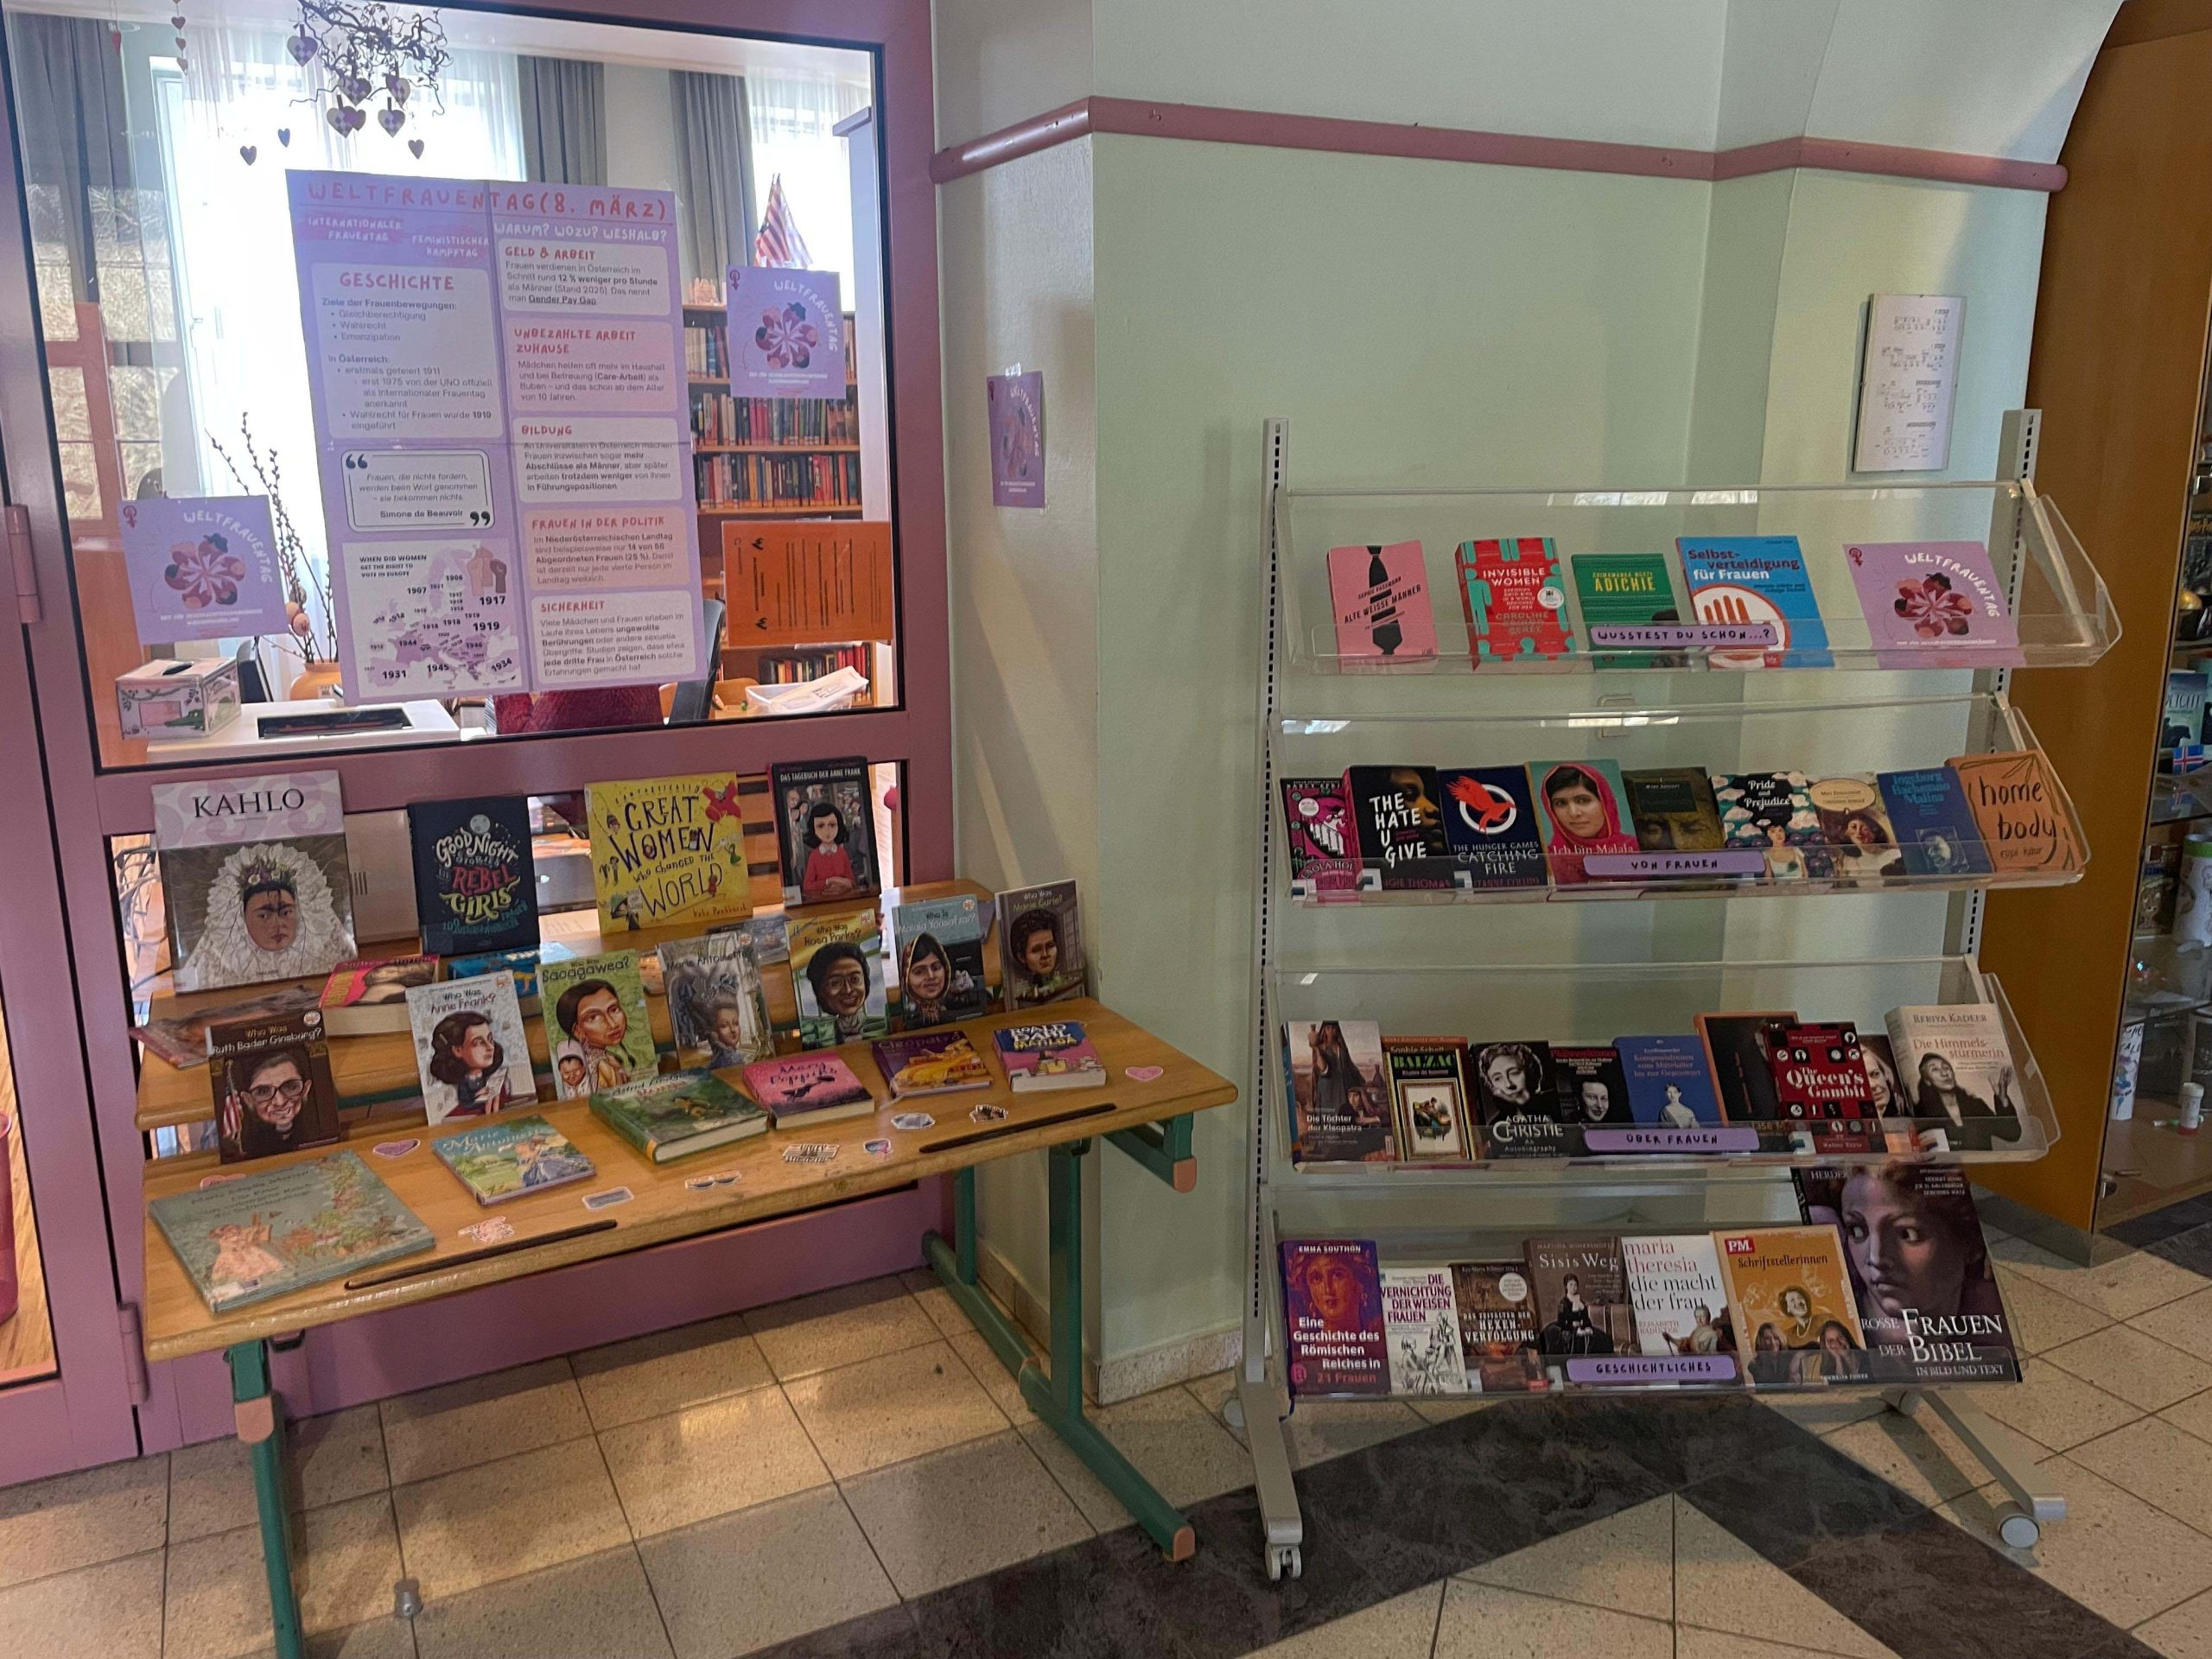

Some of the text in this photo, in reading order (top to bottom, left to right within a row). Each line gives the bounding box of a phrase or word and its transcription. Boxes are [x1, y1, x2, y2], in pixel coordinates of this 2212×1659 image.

[589, 194, 665, 220] MÄRZ)
[328, 231, 389, 242] FRAUENTAG
[494, 223, 667, 241] WARUM? WOZU? WESHALB?
[505, 246, 535, 257] GELD
[555, 249, 595, 260] ARBEIT
[340, 272, 454, 290] GESCHICHTE
[578, 276, 610, 284] weniger
[629, 276, 658, 285] Stunde
[773, 279, 838, 353] WELTFRAUENTAG
[514, 328, 636, 341] UNBEZAHLTE ARBEIT
[517, 344, 569, 354] ZUHAUSE
[521, 425, 573, 436] BILDUNG
[380, 510, 412, 518] Simone
[532, 516, 664, 530] FRAUEN IN DER POLITIK
[183, 510, 273, 583] WELTFRAUENTAG
[1688, 550, 1740, 560] Selbst-
[1708, 558, 1800, 570] verteidigung
[1483, 568, 1546, 579] INVISIBLE
[1694, 569, 1770, 581] für Frauen
[1491, 577, 1540, 587] WOMEN
[1595, 577, 1656, 592] ADICHIE
[1904, 552, 2000, 619] WELTFRAUENTAG
[479, 595, 505, 605] 1917
[1344, 584, 1421, 624] ALTE WEISSE MÄNNER
[541, 601, 605, 613] SICHERHEIT
[473, 621, 500, 632] 1919
[1599, 631, 1669, 639] WUSSTEST
[1676, 631, 1694, 639] DU
[615, 652, 656, 663] Österreich
[427, 664, 449, 673] 1945
[491, 658, 512, 672] 1934
[382, 670, 407, 680] 1931
[780, 773, 791, 782] DAS
[791, 771, 817, 781] TAGEBUCH
[818, 770, 830, 779] DER
[830, 769, 843, 778] ANNE
[1747, 780, 1776, 790] Pride
[1979, 777, 2043, 806] home
[193, 788, 305, 818] KAHLO
[1369, 792, 1405, 812] THE
[1744, 797, 1790, 810] Prejudice
[625, 796, 699, 831] GREAT
[1375, 808, 1421, 830] HATE
[1998, 810, 2057, 841] body
[1381, 830, 1391, 847] U
[608, 821, 715, 873] WOMEN
[1472, 842, 1507, 851] HUNGER
[1510, 841, 1539, 849] GAMES
[1554, 843, 1634, 855] Ich bin Malala
[700, 854, 715, 862] THE
[1385, 842, 1427, 868] GIVE
[1458, 849, 1538, 863] CATCHING
[1485, 862, 1516, 875] FIRE
[1631, 860, 1718, 870] VON FRAUEN
[452, 864, 518, 896] REBEL
[639, 863, 723, 918] WORLD
[439, 877, 520, 925] GIRLS
[804, 928, 862, 946] Rosa Parks?
[431, 994, 496, 1014] Anne Frank?
[1913, 1013, 1987, 1024] REBIYA KADEER
[1008, 1023, 1066, 1035] ROALD
[1014, 1030, 1072, 1041] DAHL
[213, 1027, 322, 1055] Ruth Bader Ginsburg?
[1014, 1037, 1077, 1051] MATILDA
[1913, 1037, 1987, 1049] Die Himmels-
[1949, 1047, 2005, 1059] stürmerin
[1393, 1055, 1453, 1068] BALZAC
[1799, 1066, 1817, 1075] The
[1786, 1069, 1864, 1090] Queen's
[1808, 1085, 1866, 1099] Gambit
[1306, 1114, 1351, 1123] Die Töchter
[1323, 1123, 1362, 1134] Kleopatra
[1492, 1120, 1564, 1142] CHRISTIE
[1626, 1134, 1718, 1145] ÜBER FRAUEN
[1624, 1239, 1675, 1255] maria
[1539, 1252, 1619, 1272] Sisis Weg
[1627, 1256, 1698, 1274] theresia
[1738, 1254, 1828, 1272] Schriftstellerinnen
[1428, 1274, 1444, 1286] DIE
[1630, 1275, 1659, 1292] die
[1663, 1273, 1717, 1291] macht
[1382, 1286, 1452, 1298] VERNICHTUNG
[1392, 1299, 1451, 1310] DER WEISEN
[1635, 1292, 1706, 1310] der frau
[1299, 1317, 1324, 1329] Eine
[1388, 1311, 1426, 1323] FRAUEN
[1861, 1308, 2003, 1336] ROSSE FRAUEN
[1479, 1319, 1521, 1331] HEXEN-
[1294, 1331, 1379, 1342] Geschichte des
[1465, 1330, 1535, 1344] VERFOLGUNG
[1301, 1344, 1364, 1356] Römischen
[1878, 1334, 1982, 1363] DER BIBEL
[1322, 1358, 1381, 1369] Reiches in
[1596, 1361, 1712, 1376] GESCHICHTLICHES
[1916, 1363, 2004, 1376] IN BILD UND TEXT
[1335, 1372, 1376, 1382] Frauen
